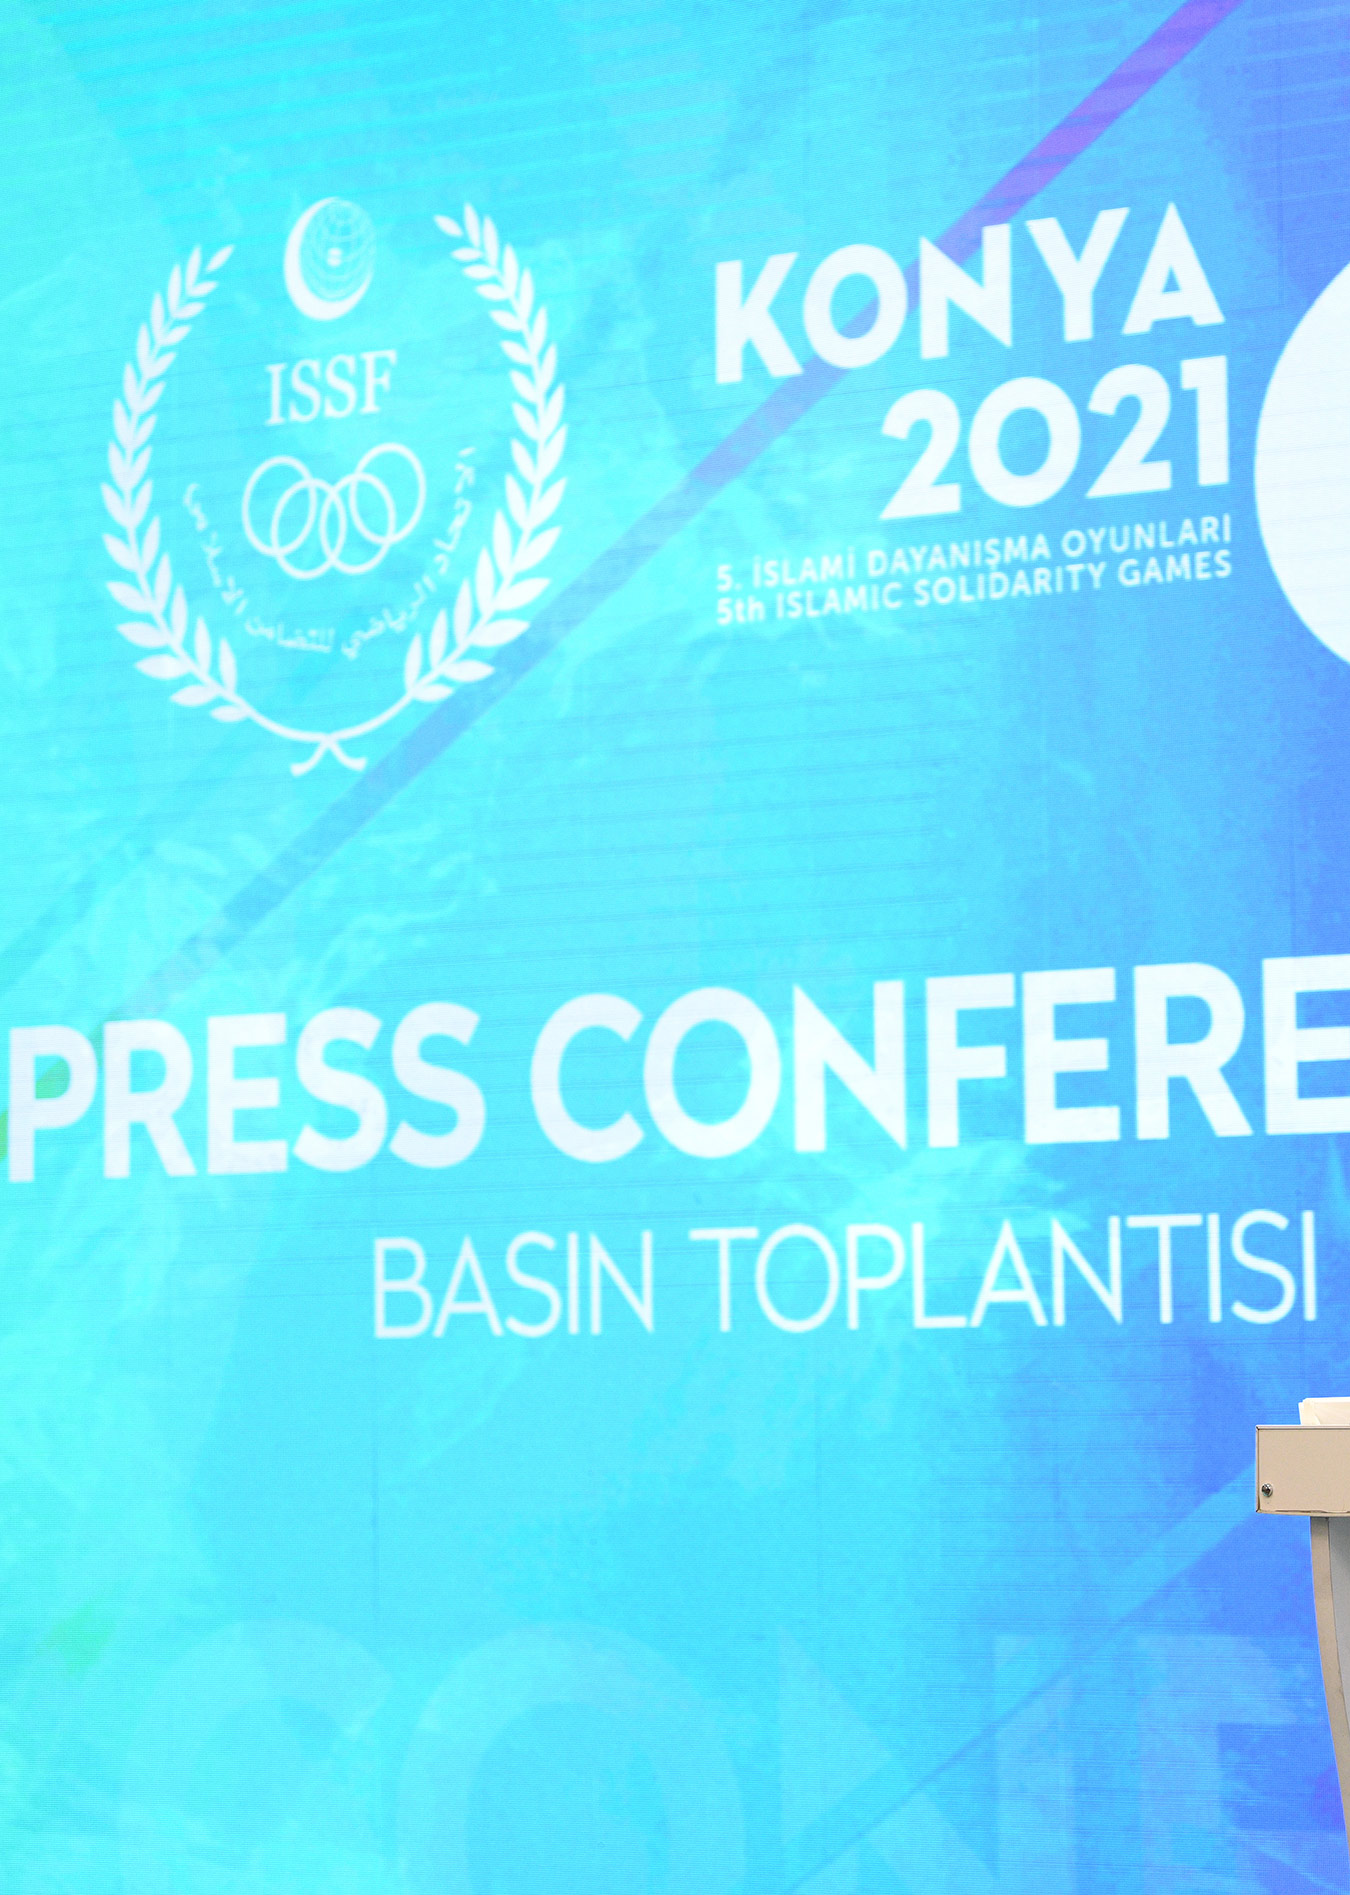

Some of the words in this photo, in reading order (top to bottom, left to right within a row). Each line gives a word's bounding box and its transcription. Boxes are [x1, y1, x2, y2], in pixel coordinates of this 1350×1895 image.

[715, 201, 1226, 385] KONYA
[265, 349, 397, 425] ISSF
[879, 355, 1230, 521] 2021
[715, 564, 743, 592] 5.
[867, 534, 1051, 579] DAYANIŞMA
[1061, 513, 1233, 557] OYUNLARI
[715, 595, 765, 626] 5th
[776, 582, 902, 620] ISLAMIC
[914, 561, 1106, 607] SOLIDARITY
[1118, 549, 1233, 588] GAMES
[8, 1001, 487, 1184] PRESS
[373, 1229, 654, 1340] BASIN
[689, 1209, 1318, 1335] TOPLANTISI
